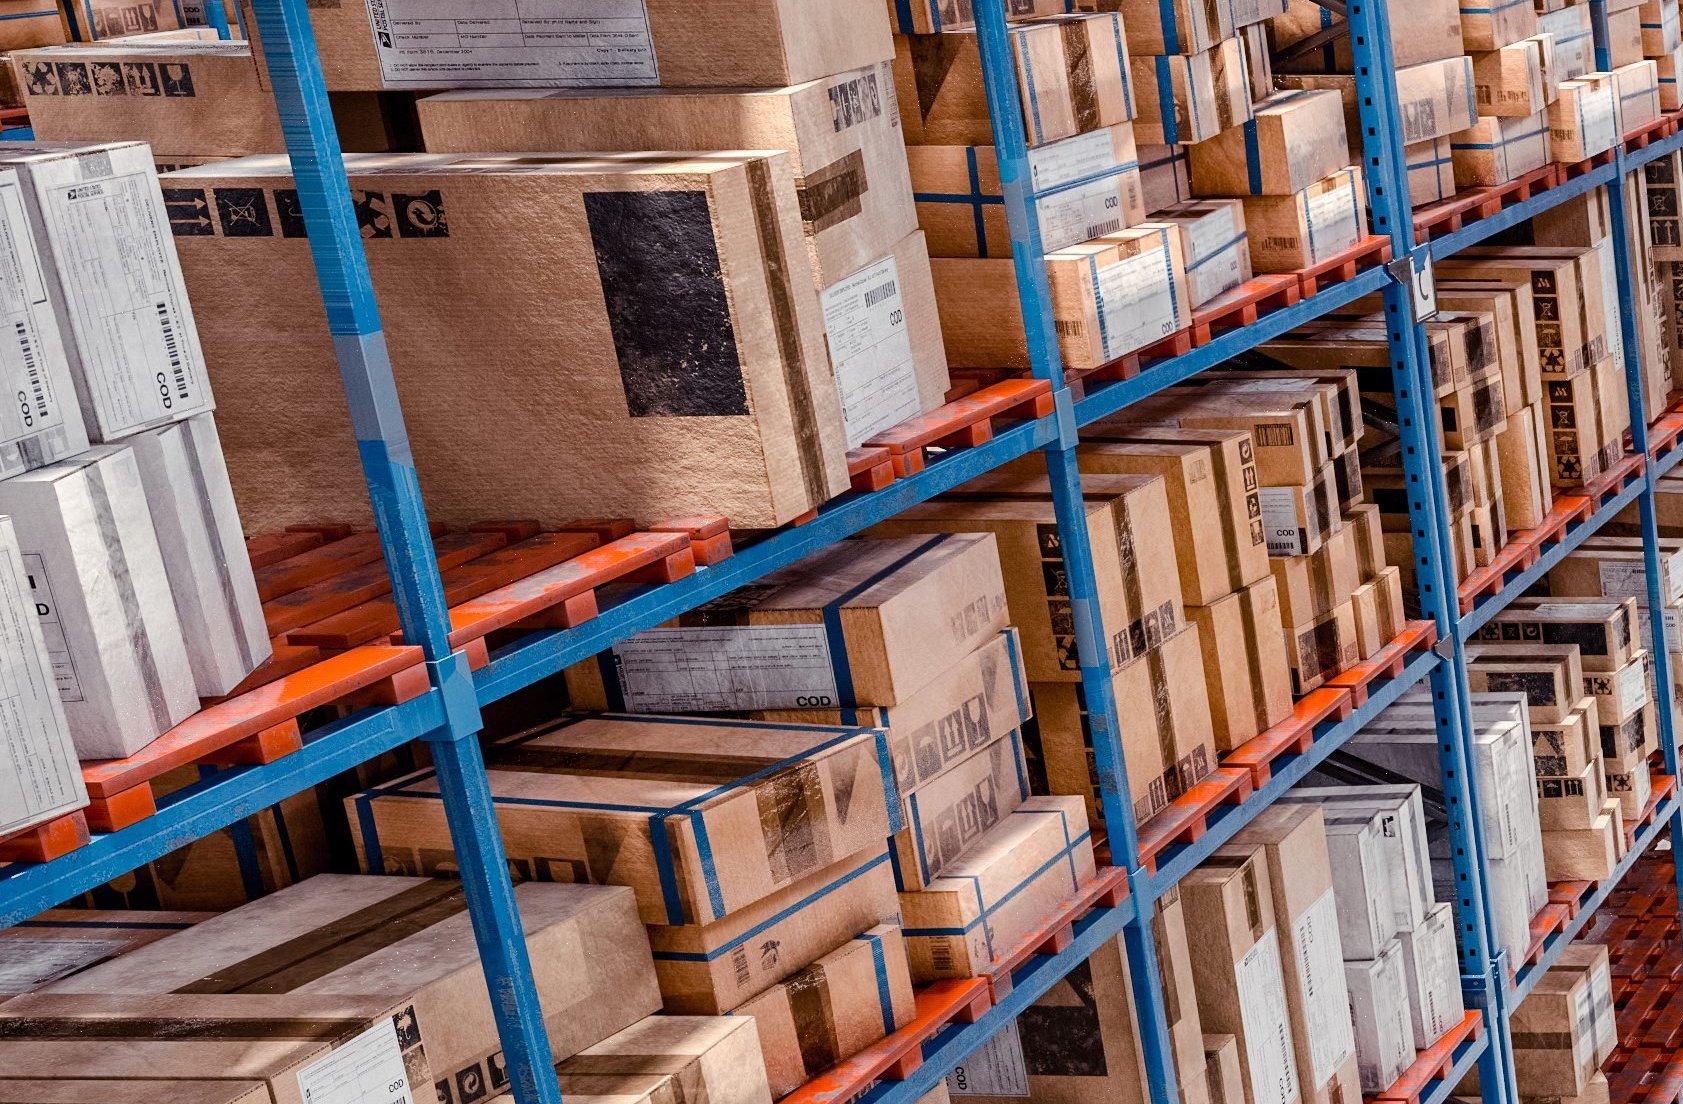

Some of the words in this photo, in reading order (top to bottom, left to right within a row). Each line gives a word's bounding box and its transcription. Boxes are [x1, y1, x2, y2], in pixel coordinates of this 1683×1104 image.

[372, 7, 382, 30] UNITED
[1105, 197, 1118, 210] COD
[890, 309, 903, 326] COD
[1161, 321, 1173, 335] COD
[156, 371, 173, 410] COD
[17, 389, 34, 428] COD
[1277, 529, 1294, 537] COD
[796, 695, 832, 707] COD
[388, 1078, 404, 1093] COD
[955, 1066, 967, 1092] COD
